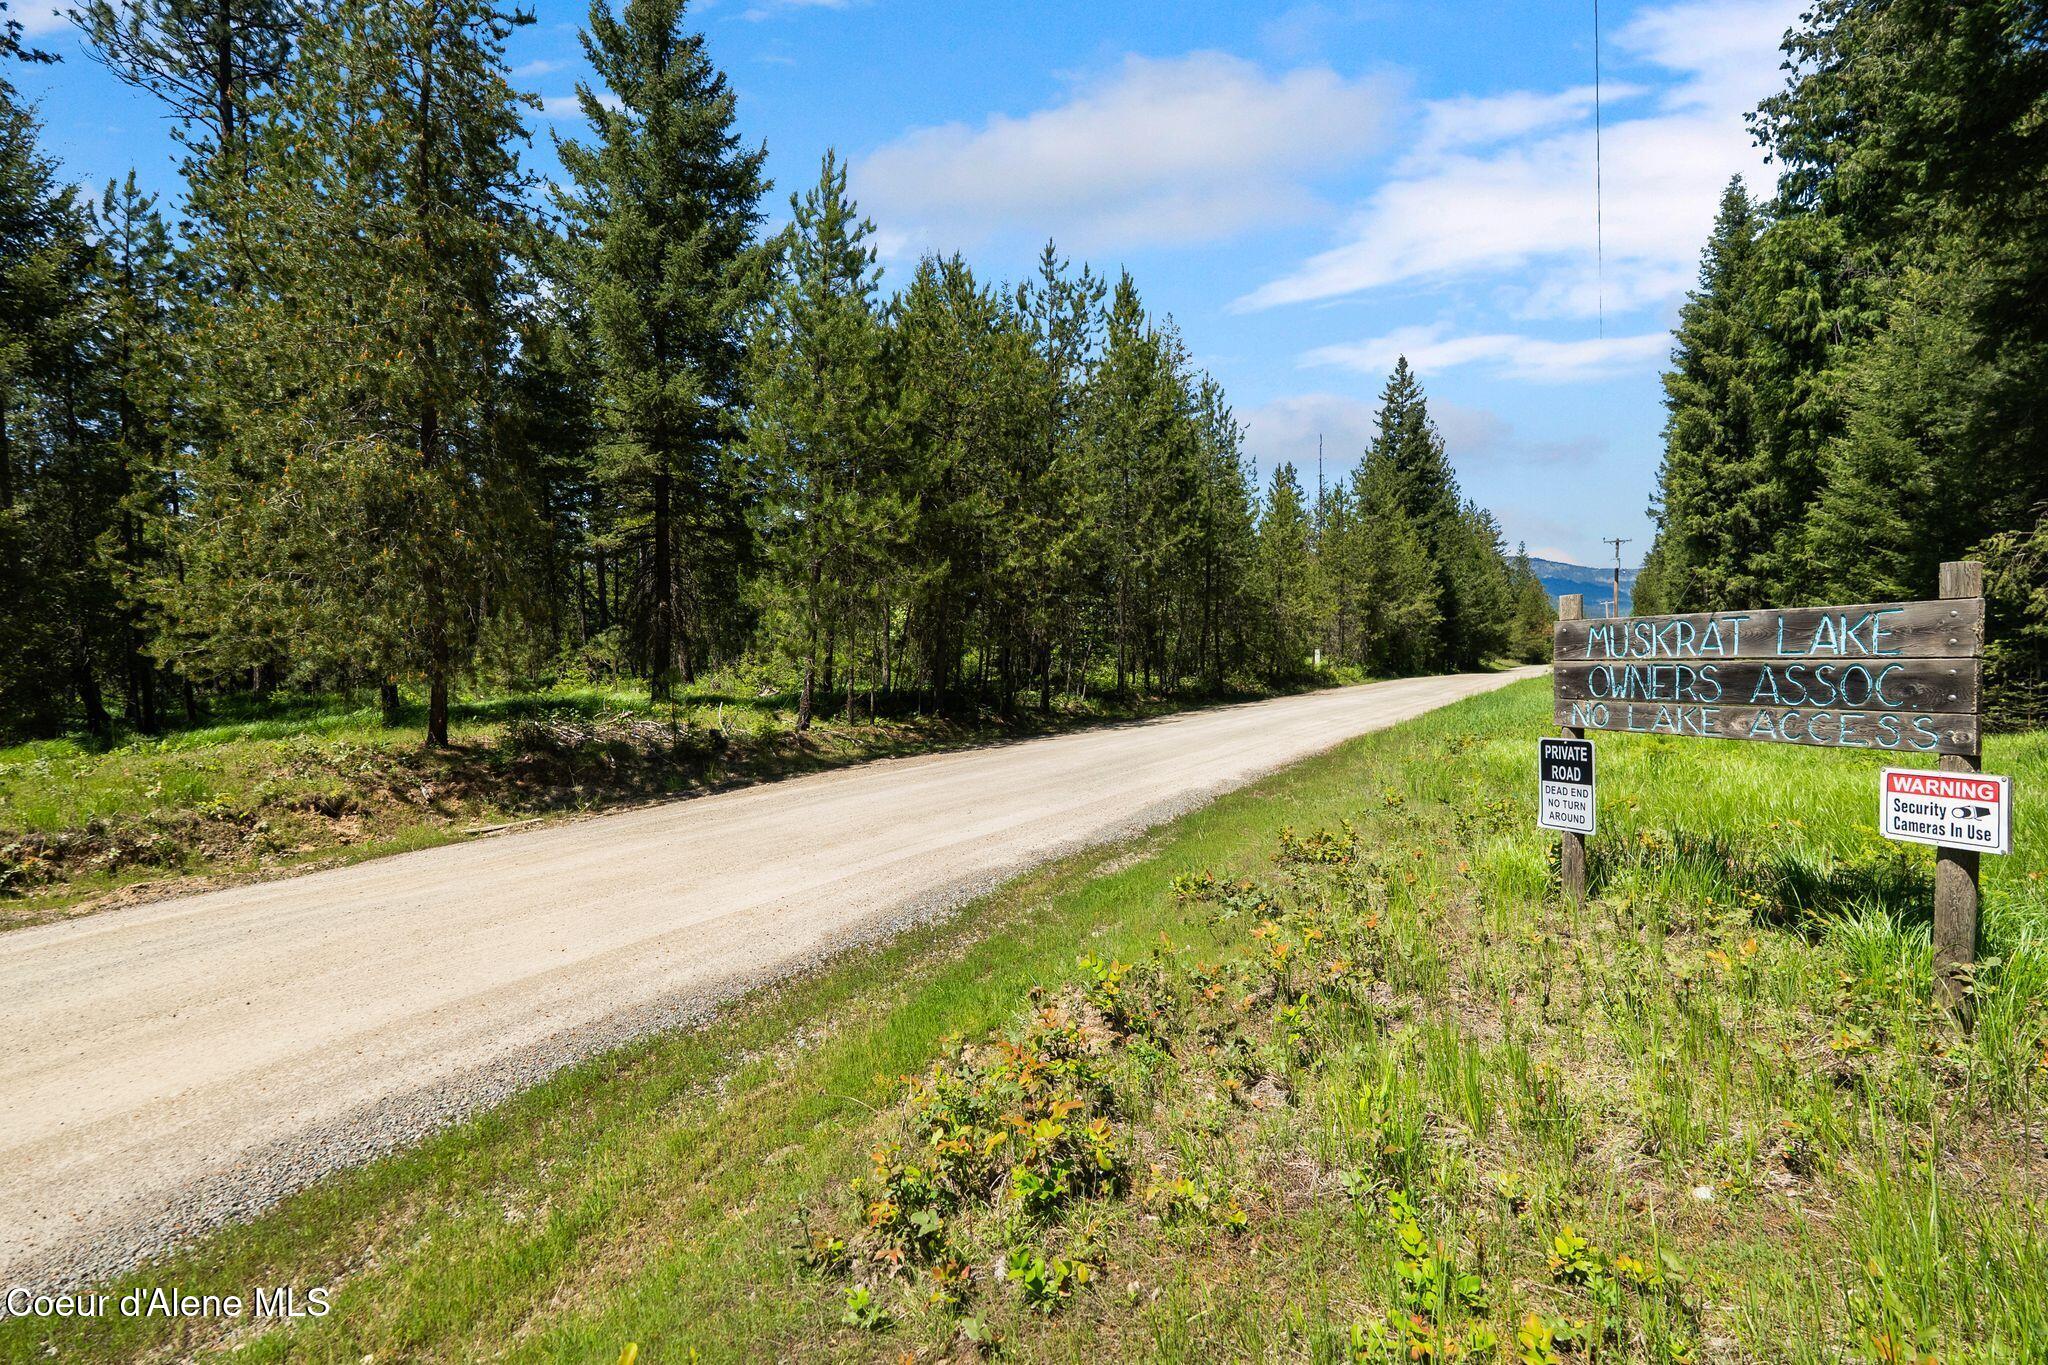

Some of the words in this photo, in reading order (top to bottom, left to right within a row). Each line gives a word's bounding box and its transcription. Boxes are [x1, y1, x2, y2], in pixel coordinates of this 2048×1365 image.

[1587, 616, 1750, 659] MUSKRAT
[1777, 608, 1904, 656] LAKE
[1588, 663, 1722, 703] OWNERS
[1572, 702, 1610, 728] NO
[1628, 704, 1721, 736] LAKE
[1750, 708, 1940, 750] ACCESS
[1545, 745, 1588, 762] PRIVATE
[1551, 765, 1581, 782] ROAD
[1545, 785, 1568, 796] DEAD
[1570, 788, 1589, 799] END
[1893, 776, 1994, 800] WARNING
[1548, 798, 1560, 808] NO
[1562, 799, 1586, 811] TURN
[1893, 798, 1947, 820] Security
[1549, 811, 1586, 824] AROUND
[1894, 816, 1946, 836] Cameras
[1950, 822, 1963, 838] In
[1967, 824, 1991, 842] Use
